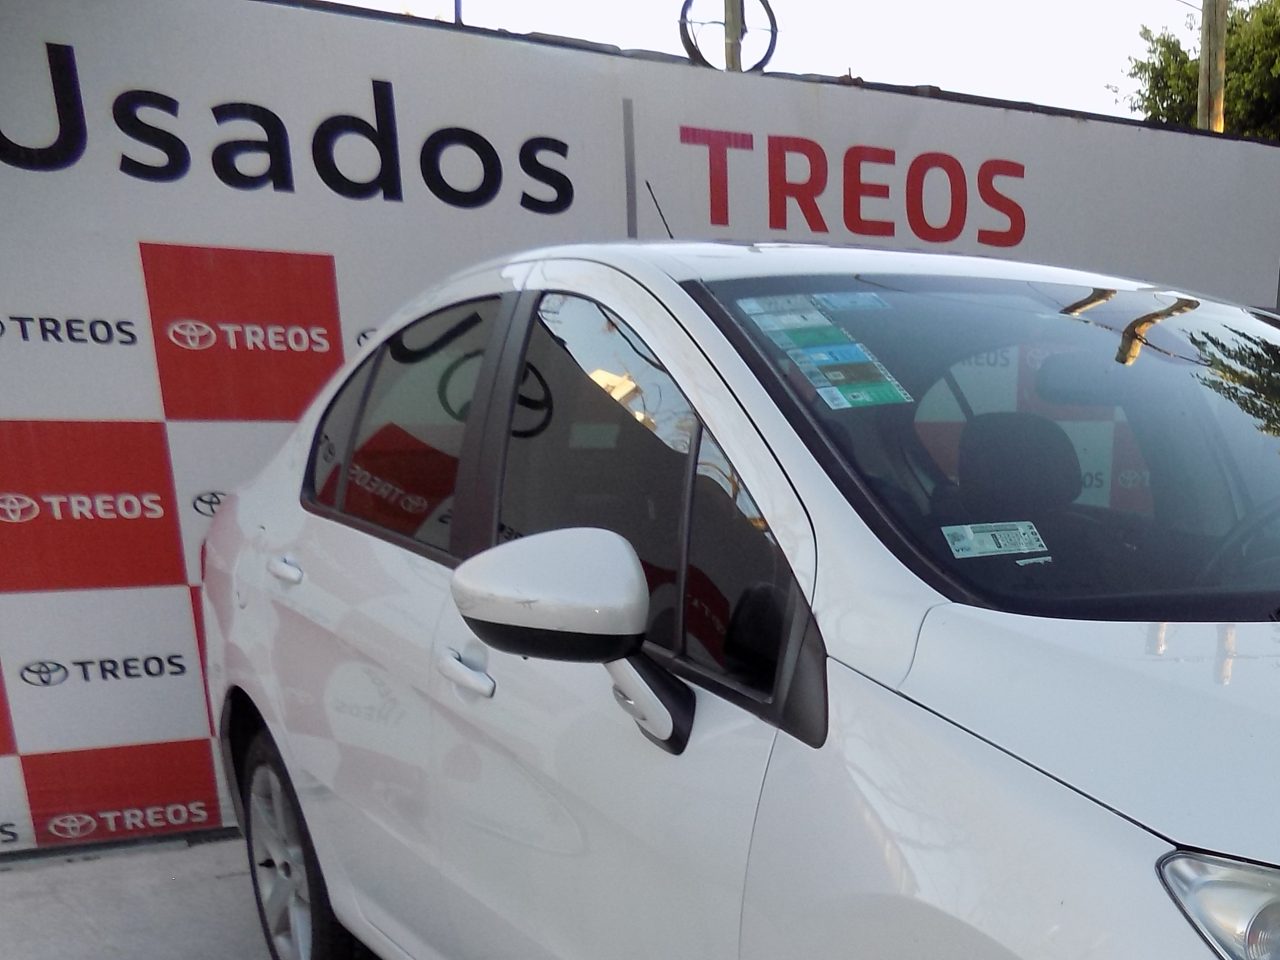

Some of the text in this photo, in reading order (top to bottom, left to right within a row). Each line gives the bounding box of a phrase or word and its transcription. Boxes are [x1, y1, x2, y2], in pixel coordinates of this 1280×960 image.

[679, 125, 1026, 247] TREOS
[9, 316, 138, 346] TREOS
[218, 323, 330, 352] TREOS
[41, 494, 165, 520] TREOS
[72, 655, 187, 682] TREOS
[98, 801, 208, 832] TREOS
